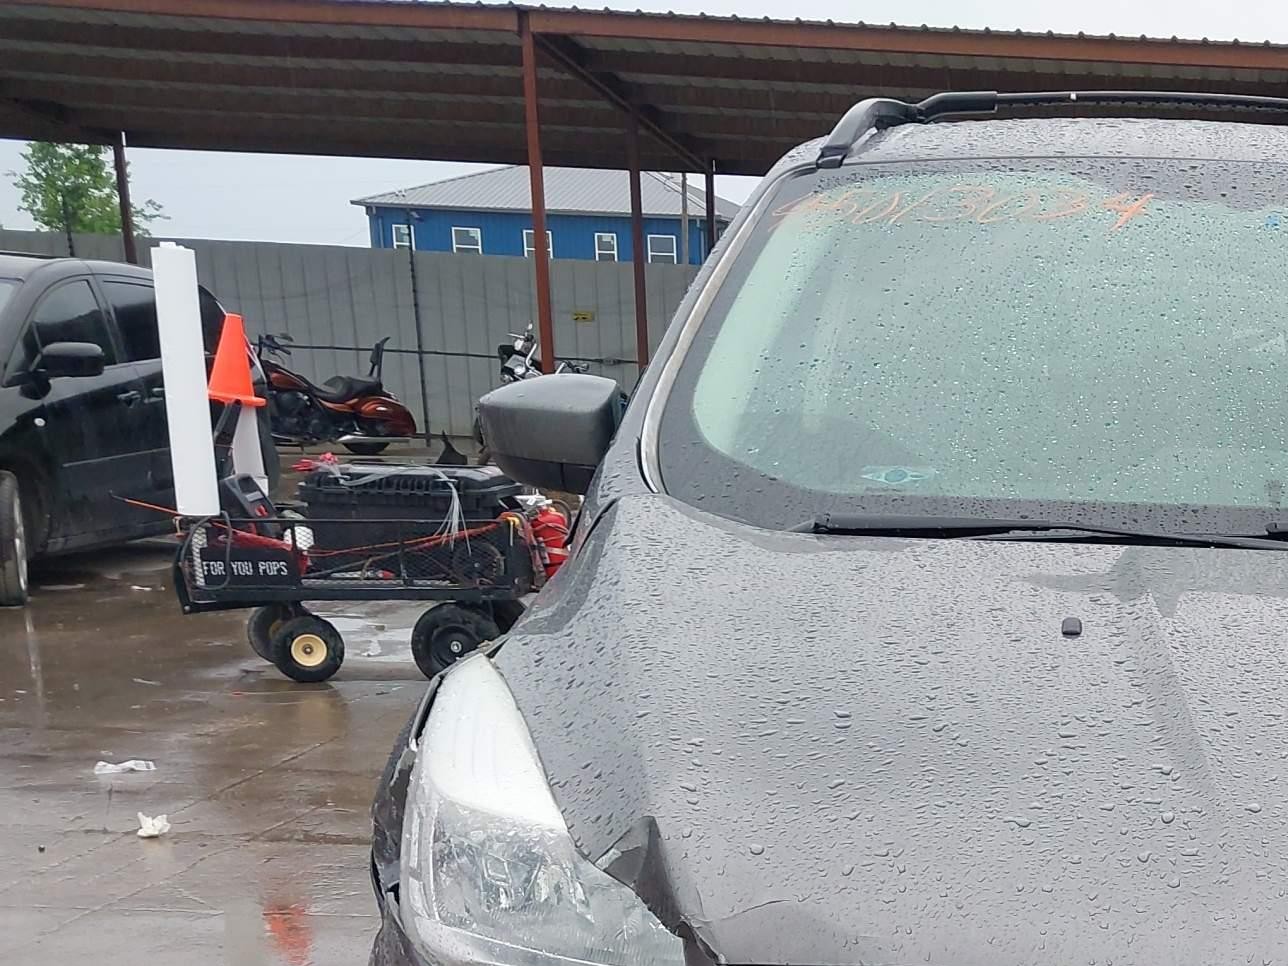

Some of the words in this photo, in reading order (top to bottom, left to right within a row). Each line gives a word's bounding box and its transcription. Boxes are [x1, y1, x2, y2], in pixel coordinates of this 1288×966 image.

[202, 561, 226, 576] FOR
[230, 561, 254, 576] YOU
[258, 561, 288, 576] POPS
